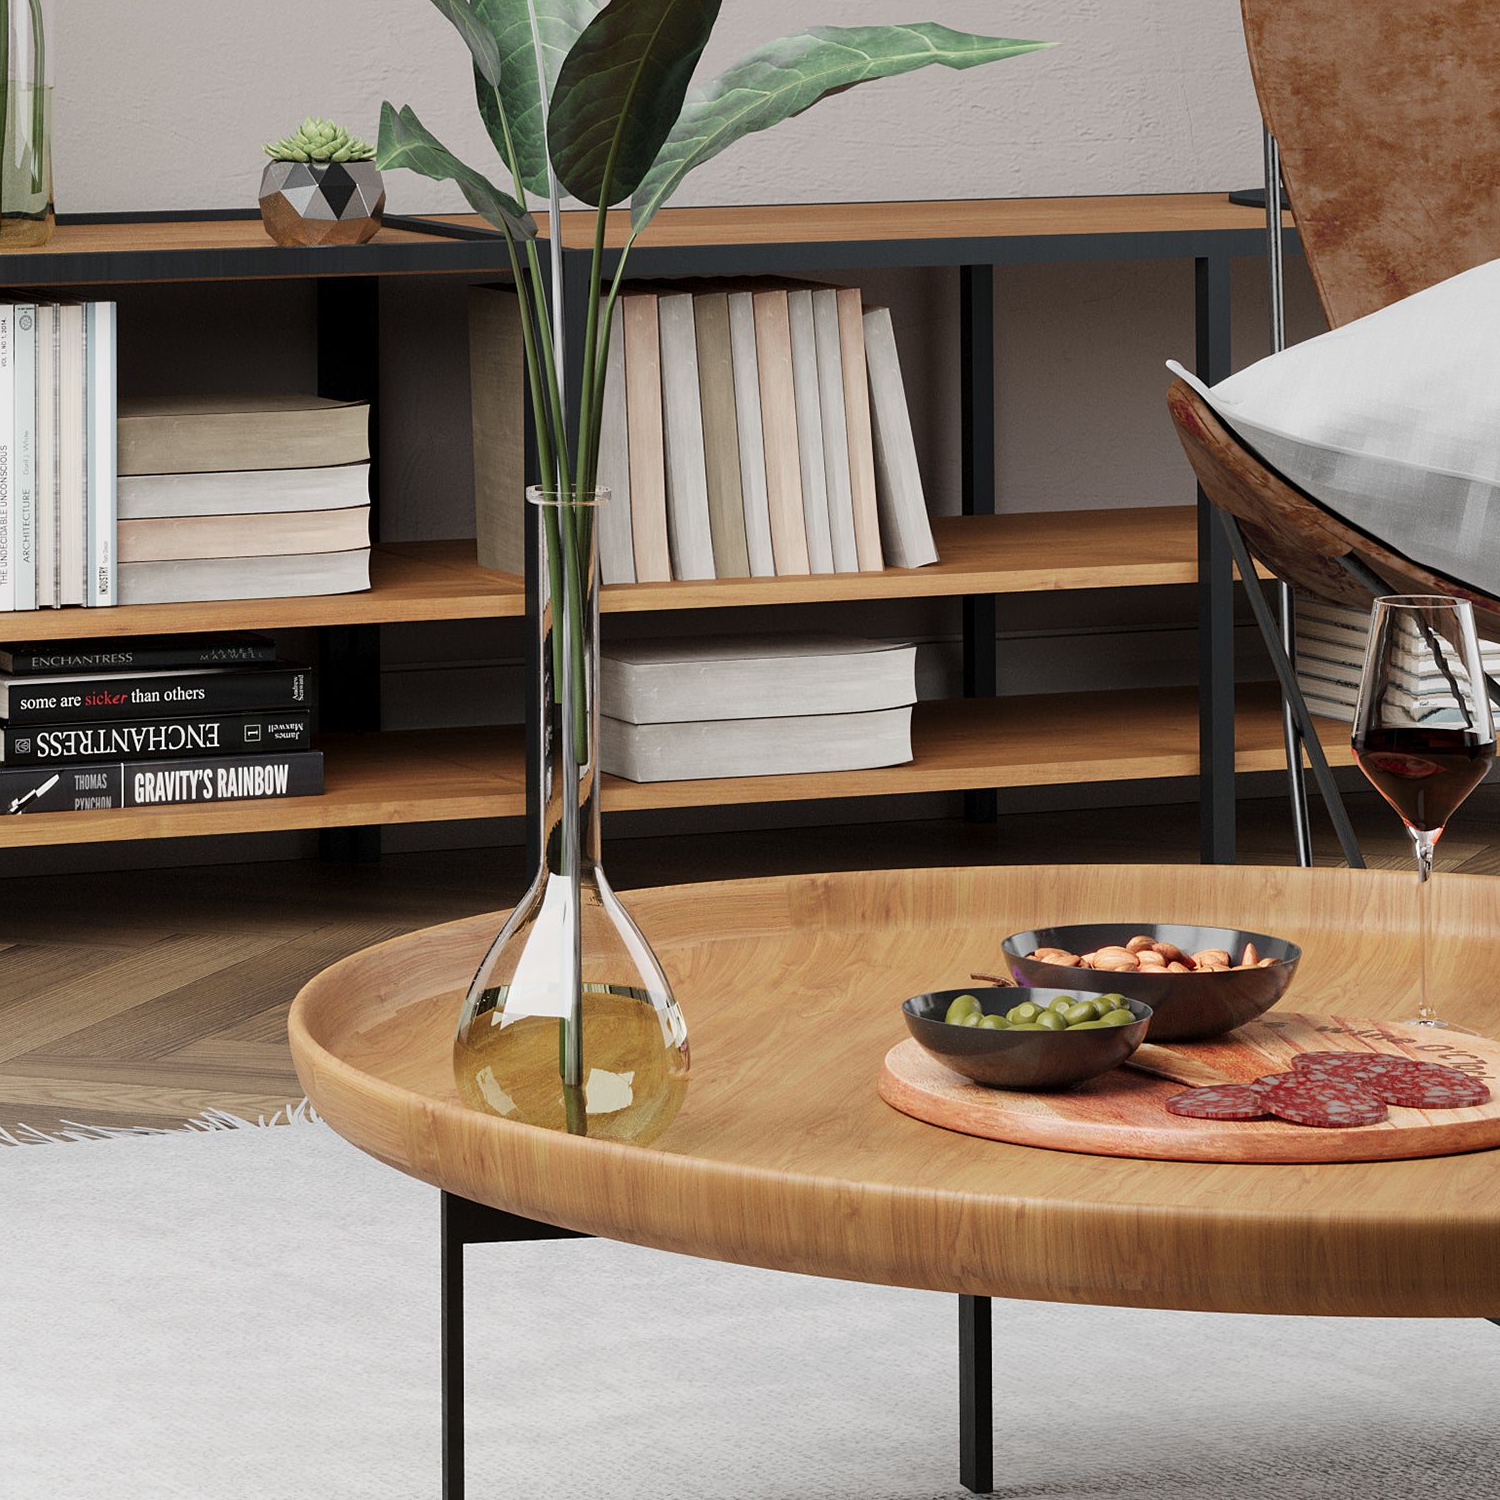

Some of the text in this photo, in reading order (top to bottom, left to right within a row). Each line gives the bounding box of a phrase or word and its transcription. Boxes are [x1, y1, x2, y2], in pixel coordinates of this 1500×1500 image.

[0, 445, 8, 586] THE UNDECIDABLE UNCONSCIOUS
[22, 489, 31, 564] ARCHITECTURE
[98, 566, 108, 596] INDUSTRY
[31, 651, 133, 668] ENCHANTRESS
[200, 652, 263, 661] MAXWELL
[210, 646, 253, 655] JAMES
[20, 686, 206, 710] some are sicker than others
[268, 723, 304, 733] Maxwell
[274, 731, 301, 740] James
[37, 723, 221, 758] ENCHANTRESS
[74, 773, 108, 791] THOMAS
[134, 764, 289, 804] GRAVITY'S RAINBOW
[74, 796, 112, 810] PYNCHON
[1315, 1025, 1417, 1044] wine
